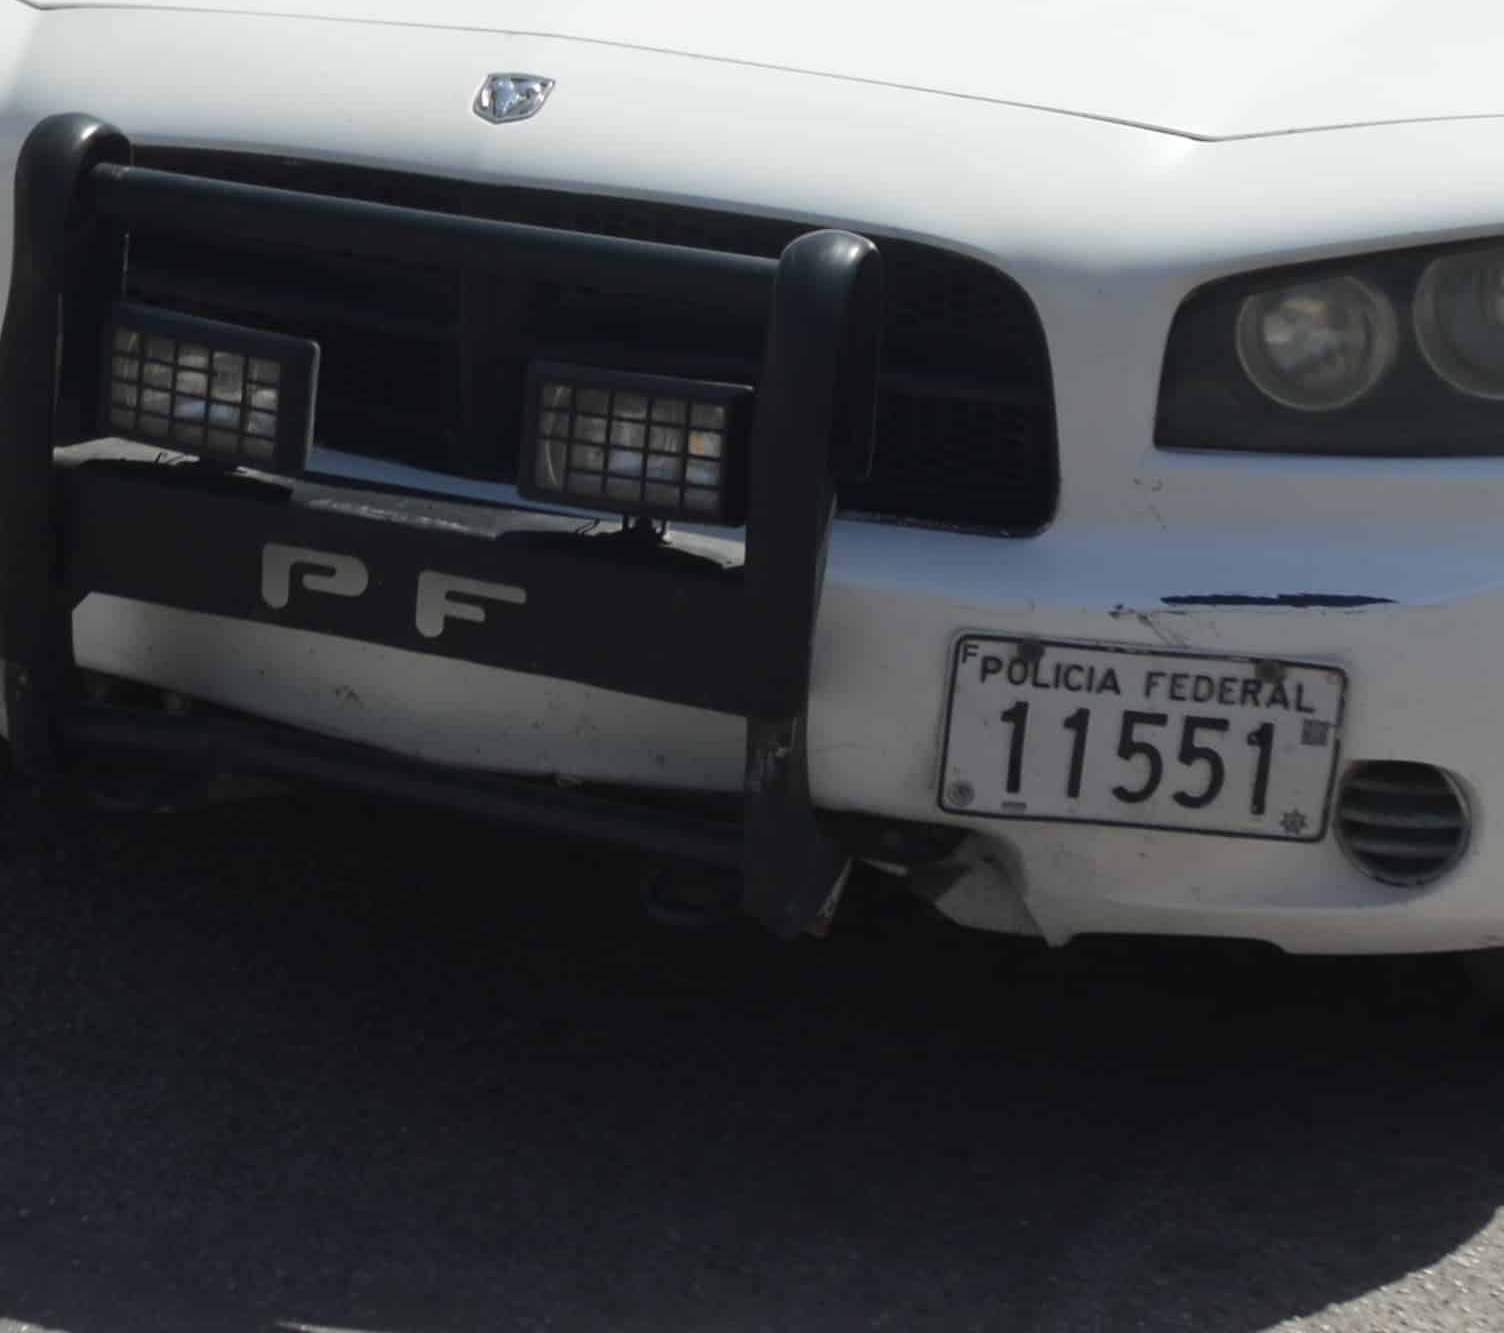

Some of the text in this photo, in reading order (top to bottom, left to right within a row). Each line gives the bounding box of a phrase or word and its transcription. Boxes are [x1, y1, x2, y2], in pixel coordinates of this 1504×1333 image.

[978, 654, 1317, 714] POLICIA FEDERAL
[1000, 700, 1275, 816] 11551
